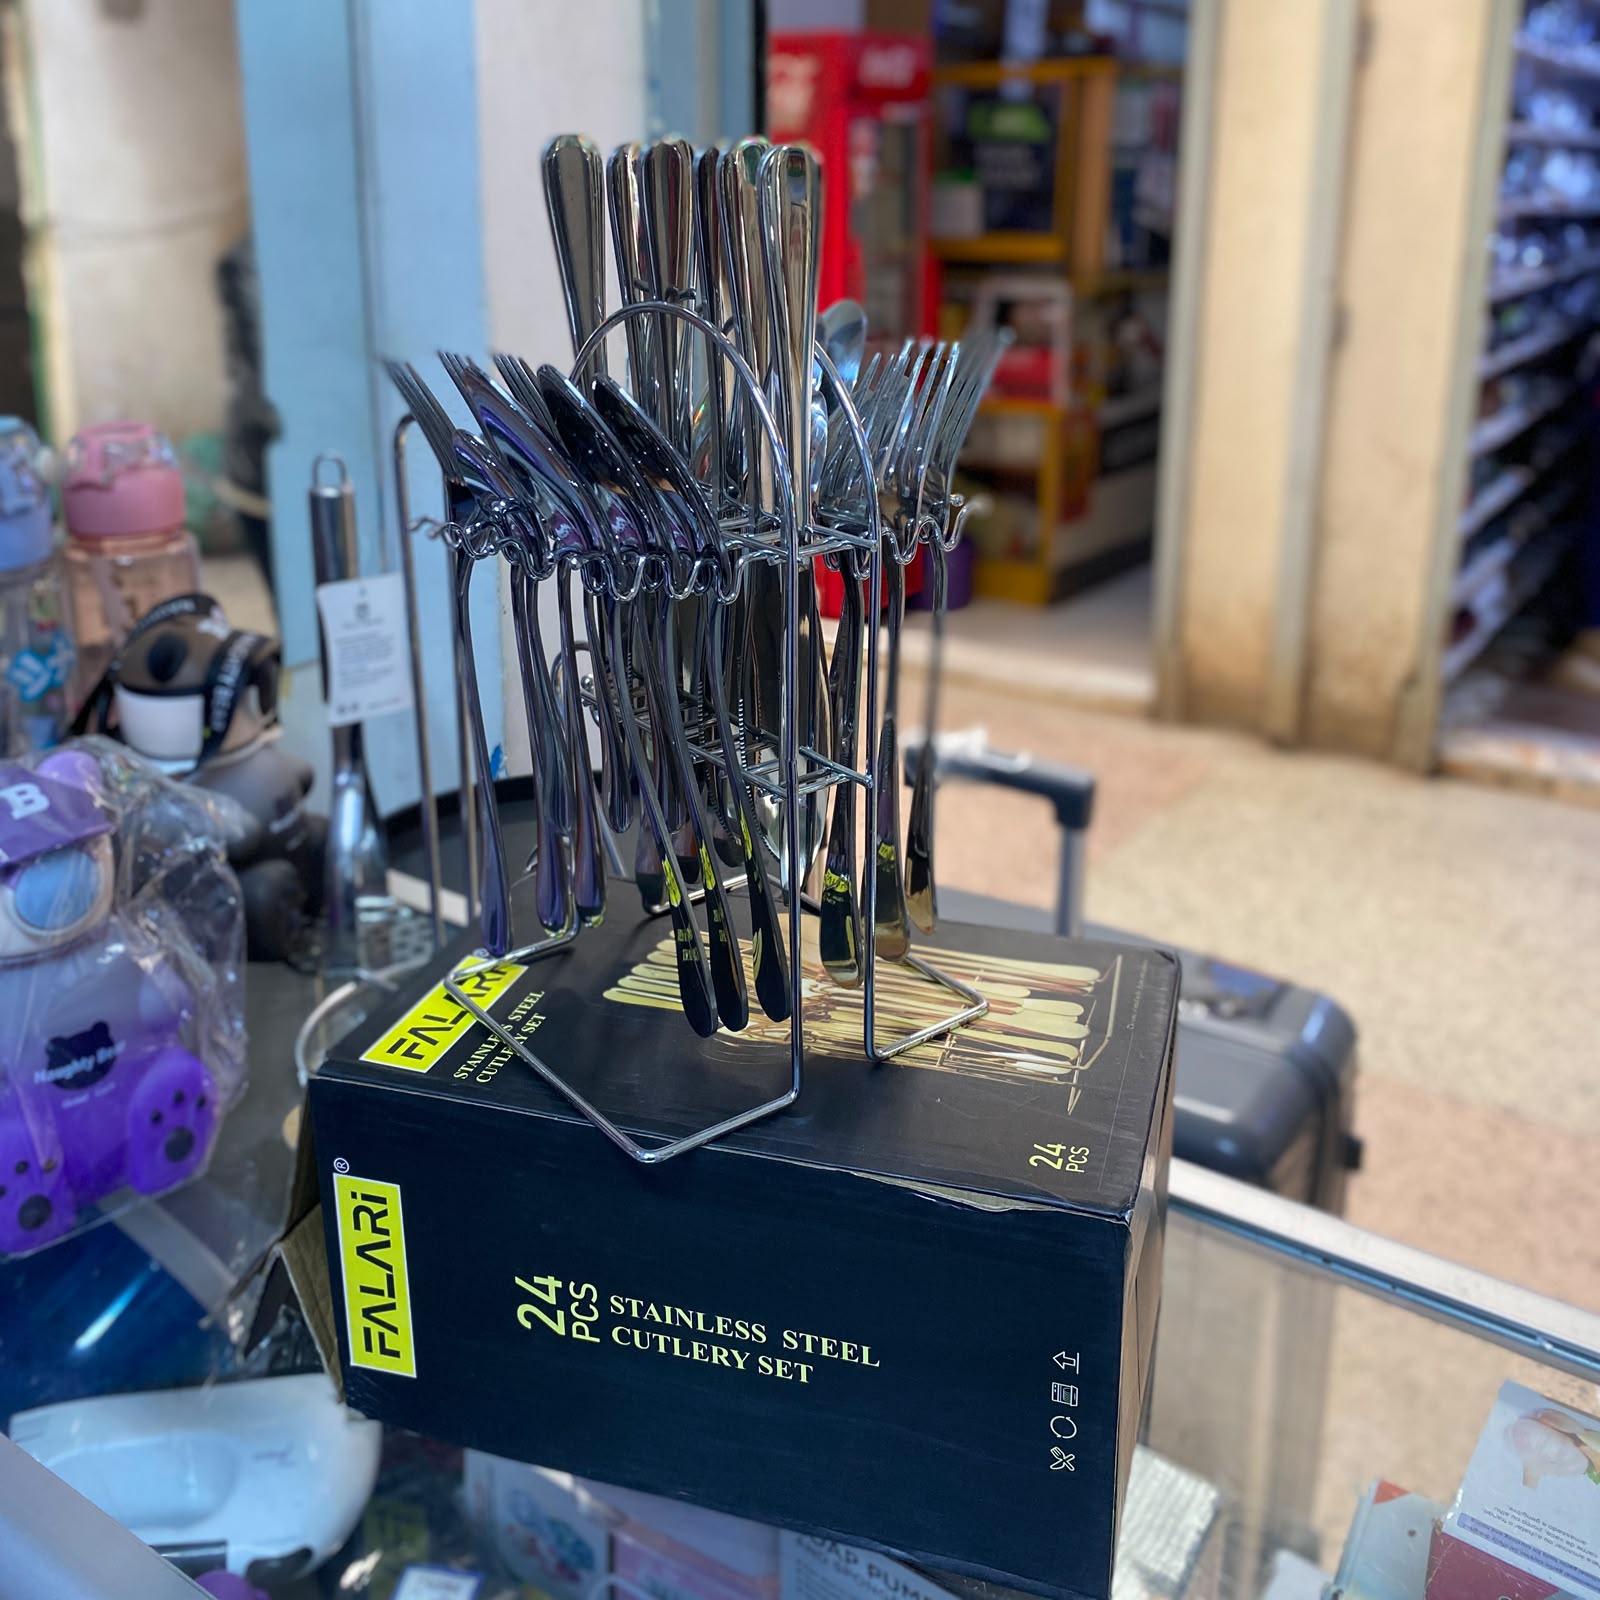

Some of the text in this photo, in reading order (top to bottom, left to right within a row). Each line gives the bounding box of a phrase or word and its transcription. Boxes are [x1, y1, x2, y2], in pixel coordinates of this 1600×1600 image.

[453, 991, 545, 1079] STAINLES STEEL
[476, 1013, 546, 1082] CUTLEY SET
[1028, 1143, 1066, 1170] 24
[1066, 1146, 1089, 1173] PCS
[515, 1275, 566, 1336] 24
[569, 1280, 600, 1343] PCS
[609, 1295, 880, 1367] STAINLESS STEEL
[611, 1326, 814, 1383] CUTLERY SET
[797, 1535, 859, 1565] OAP
